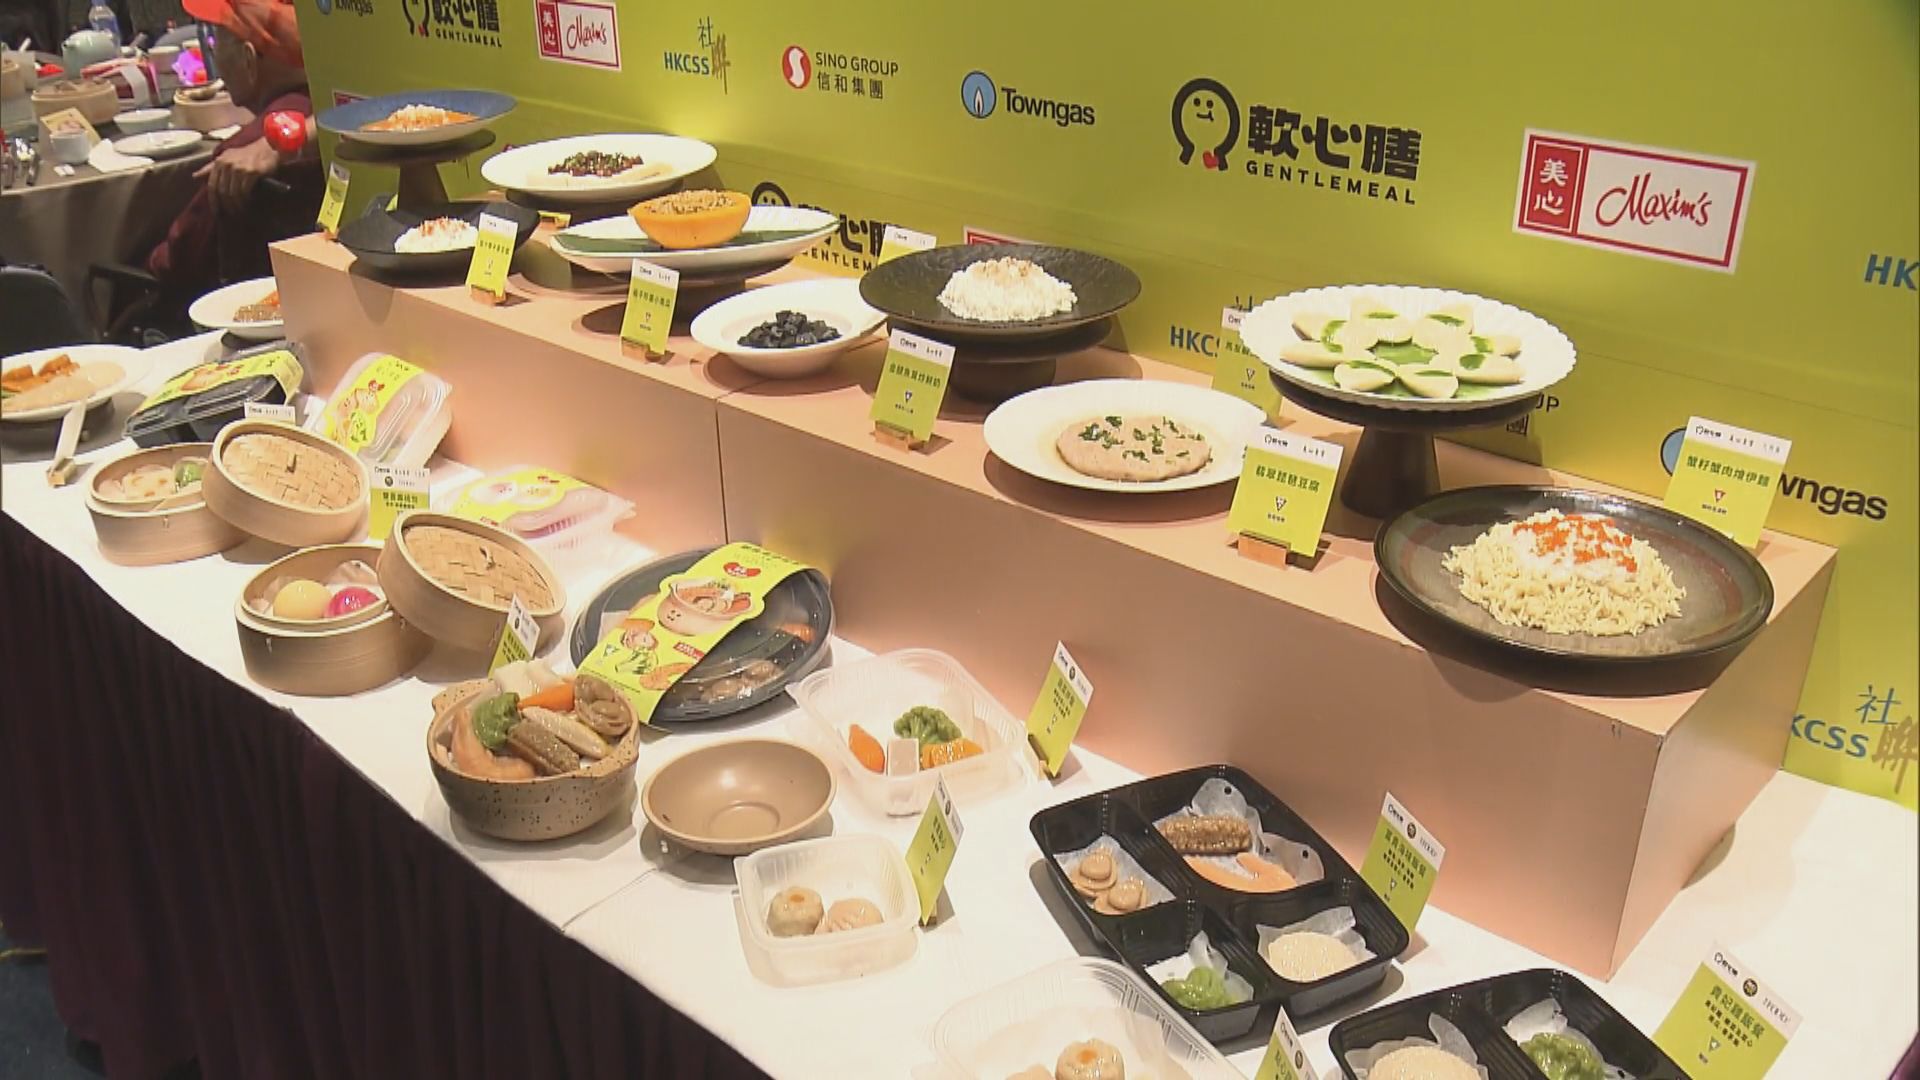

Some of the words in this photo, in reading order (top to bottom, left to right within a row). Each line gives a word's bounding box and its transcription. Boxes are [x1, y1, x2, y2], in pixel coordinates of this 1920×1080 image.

[435, 28, 502, 48] GENTLEMEAL
[566, 14, 608, 50] Maxim's
[664, 52, 710, 75] HKCSS
[815, 51, 848, 70] SINO
[850, 55, 899, 76] GROUP
[816, 71, 884, 99] 信和集團
[1001, 86, 1095, 126] Towngas
[1247, 104, 1422, 181] 軟心膳
[1246, 159, 1416, 205] GENTLEMEAL
[1533, 158, 1569, 216] 美心
[1594, 172, 1713, 228] Maxim's
[801, 247, 873, 272] ENTLEM
[1170, 324, 1221, 358] HKC
